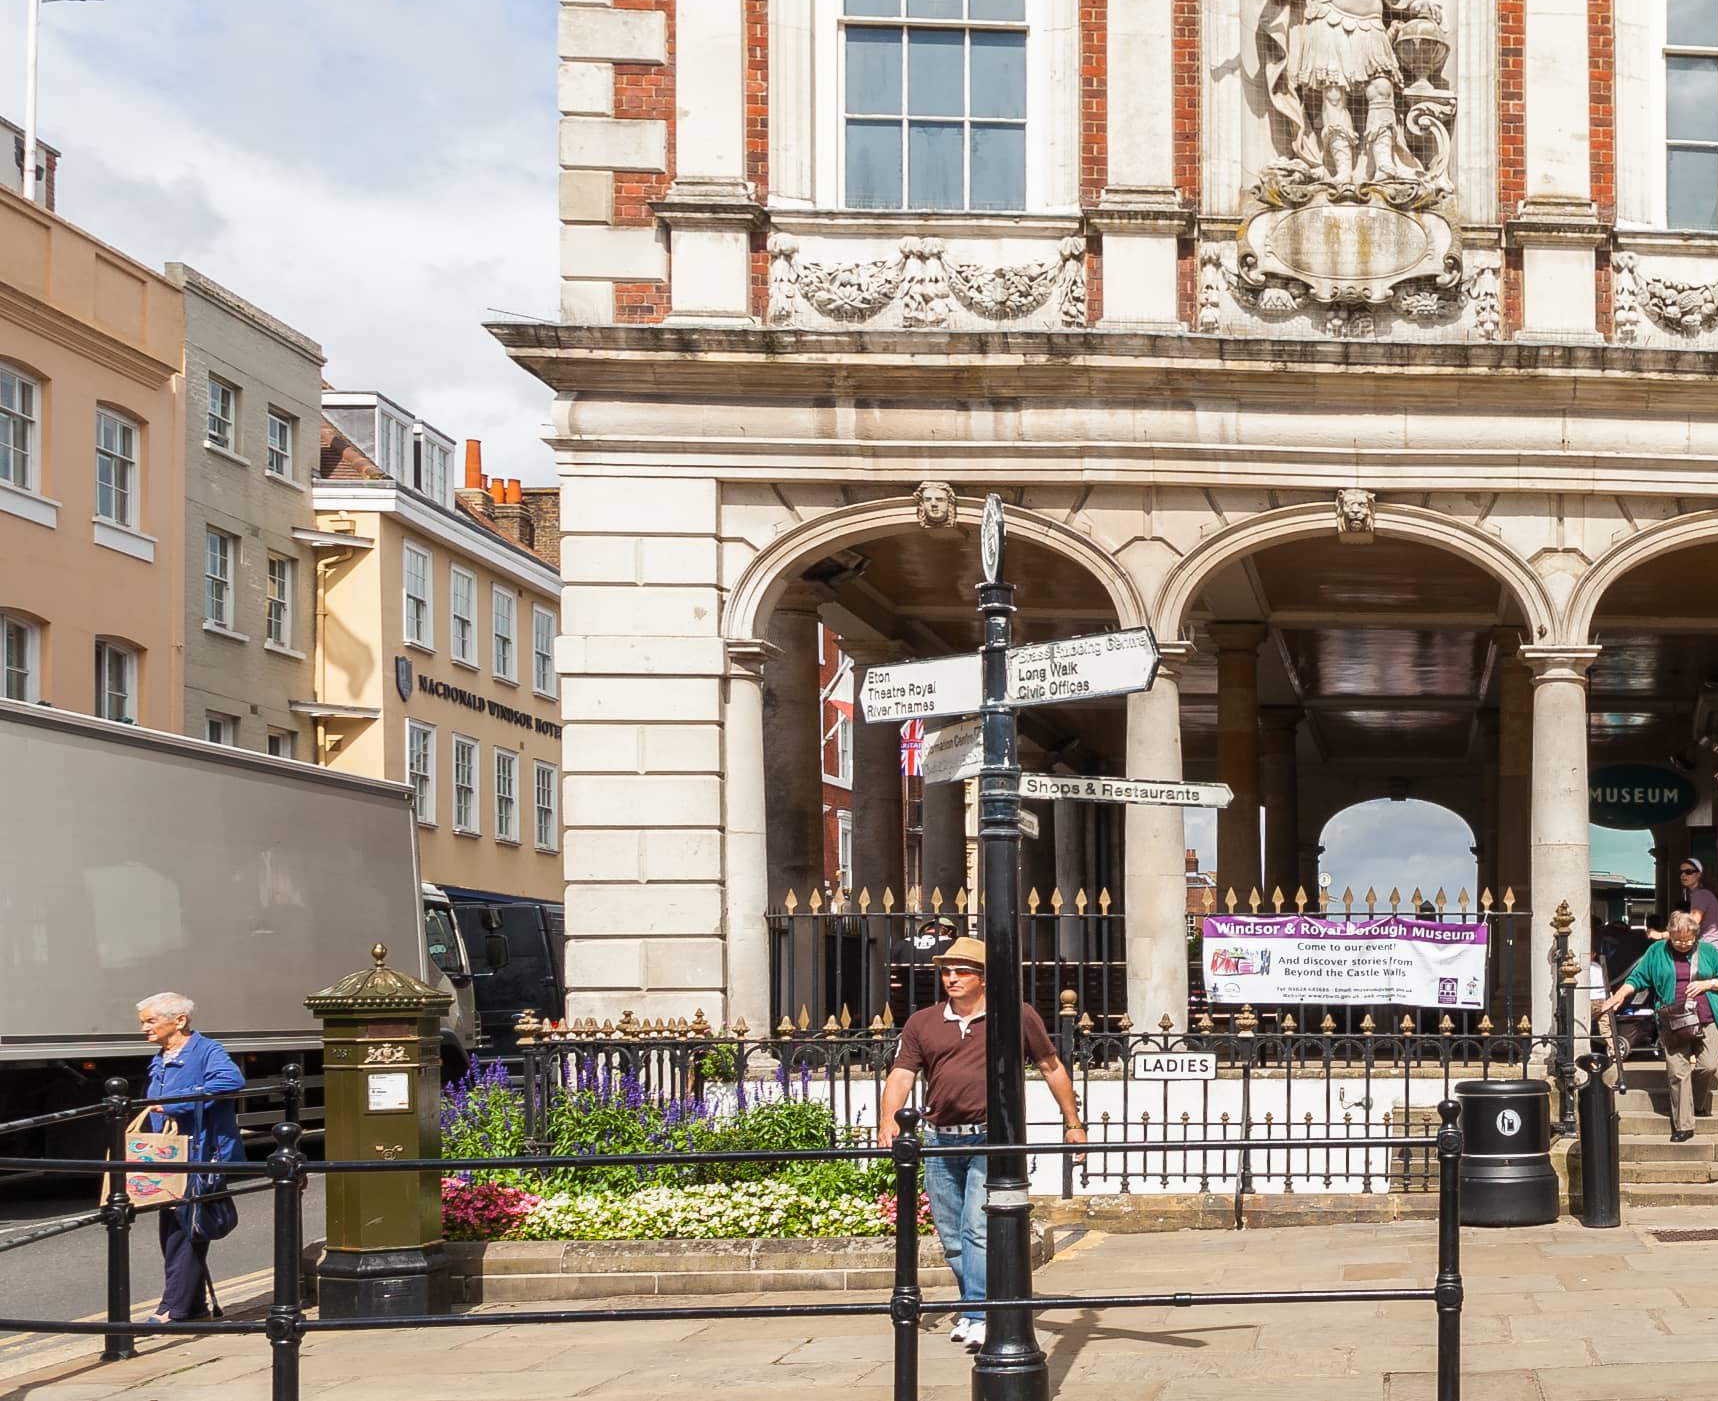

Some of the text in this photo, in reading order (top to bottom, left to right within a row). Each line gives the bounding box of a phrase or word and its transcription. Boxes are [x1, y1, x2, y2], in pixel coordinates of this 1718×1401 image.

[1054, 641, 1101, 659] Rubbing
[1106, 636, 1147, 652] Centre
[868, 671, 890, 684] Eton
[1018, 662, 1078, 682] Long Walk
[868, 681, 936, 700] Theatre Royal
[1018, 680, 1089, 699] Civic Offices
[418, 674, 485, 713] MACDONALD
[487, 700, 534, 730] WINDSOR
[867, 700, 935, 718] River Thames
[1026, 779, 1200, 801] Shops & Restaurants
[1590, 787, 1679, 803] MUSEUM
[1216, 922, 1280, 935] Windsor
[1284, 923, 1296, 935] &
[1301, 922, 1341, 938] Royal
[1412, 927, 1475, 941] Museum
[1297, 943, 1326, 951] Come
[1330, 943, 1340, 951] to
[1366, 943, 1397, 951] event!
[1278, 956, 1413, 966] And discover stories from
[1284, 967, 1406, 977] Beyond the Castle Walls
[1143, 1058, 1209, 1073] LADIES
